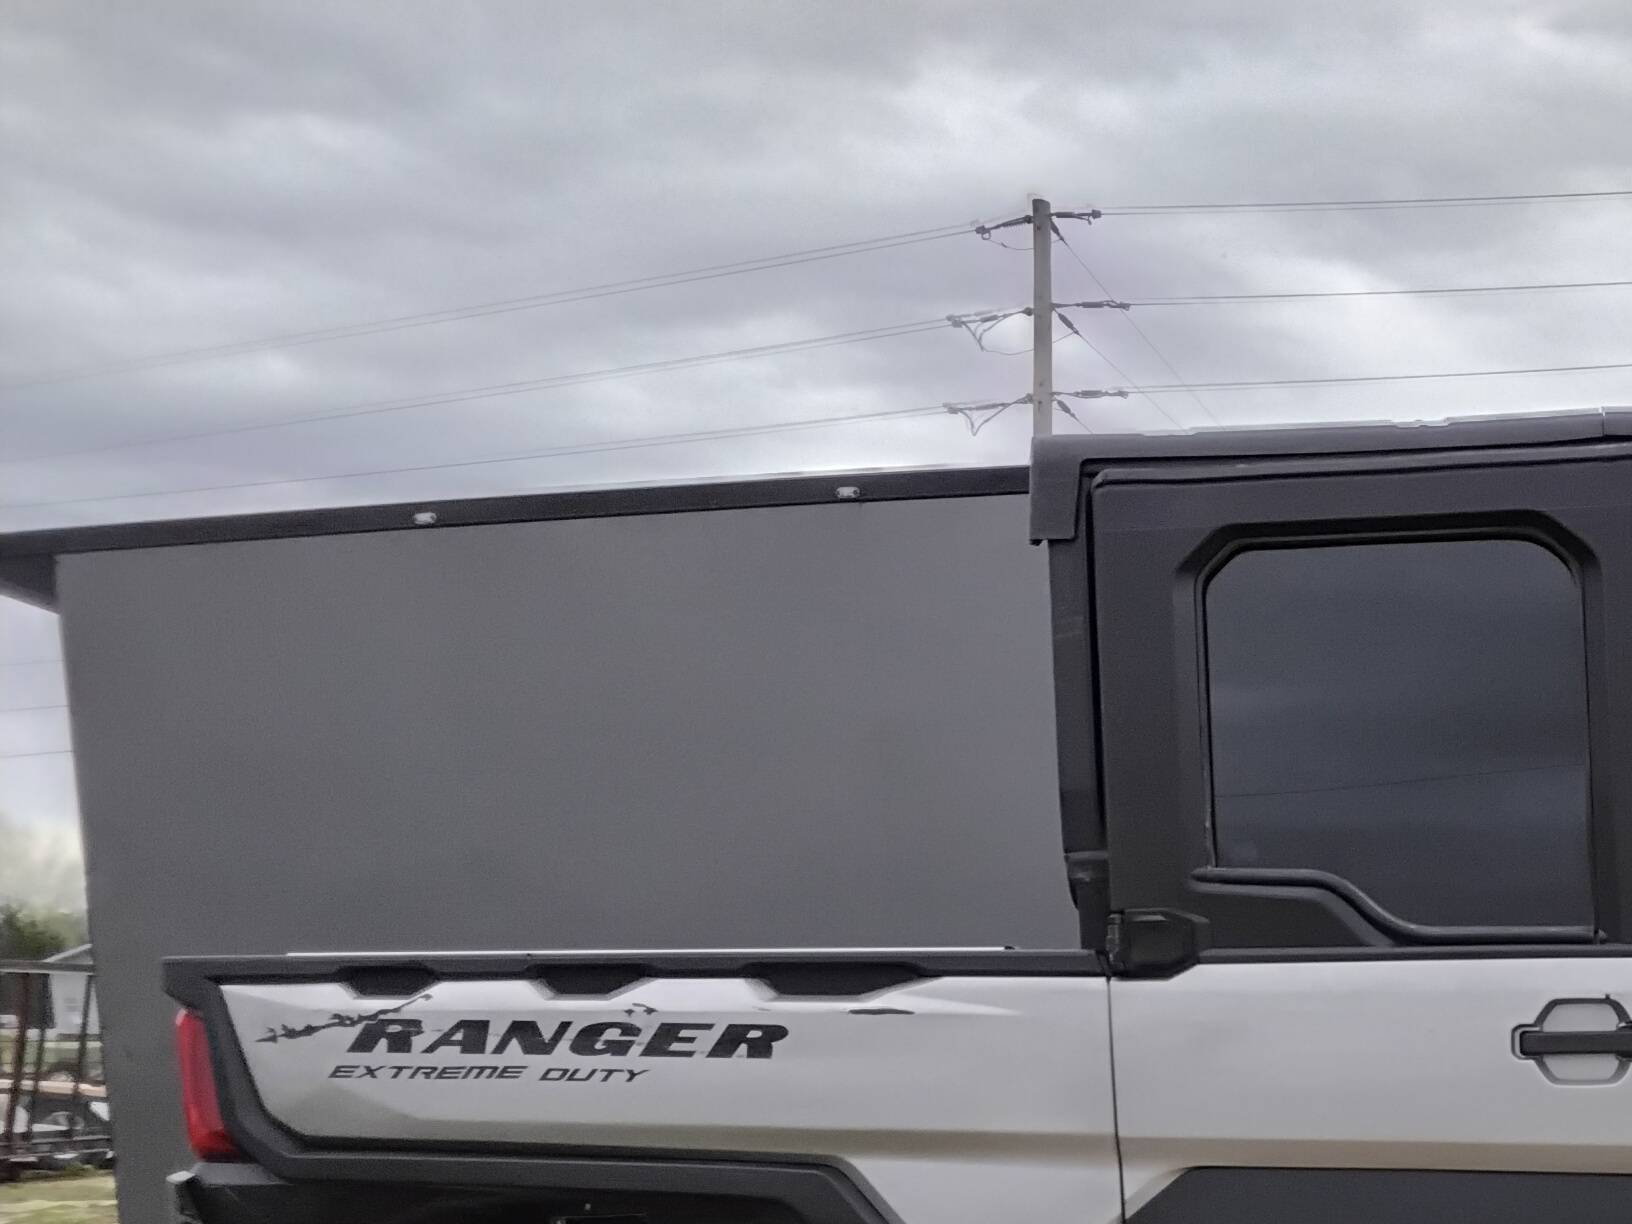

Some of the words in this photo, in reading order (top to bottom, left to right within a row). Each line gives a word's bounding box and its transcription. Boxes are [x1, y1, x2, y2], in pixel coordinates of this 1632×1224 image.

[347, 1018, 789, 1059] RANGER
[328, 1065, 528, 1080] EXTREME
[539, 1067, 650, 1083] DUTY
